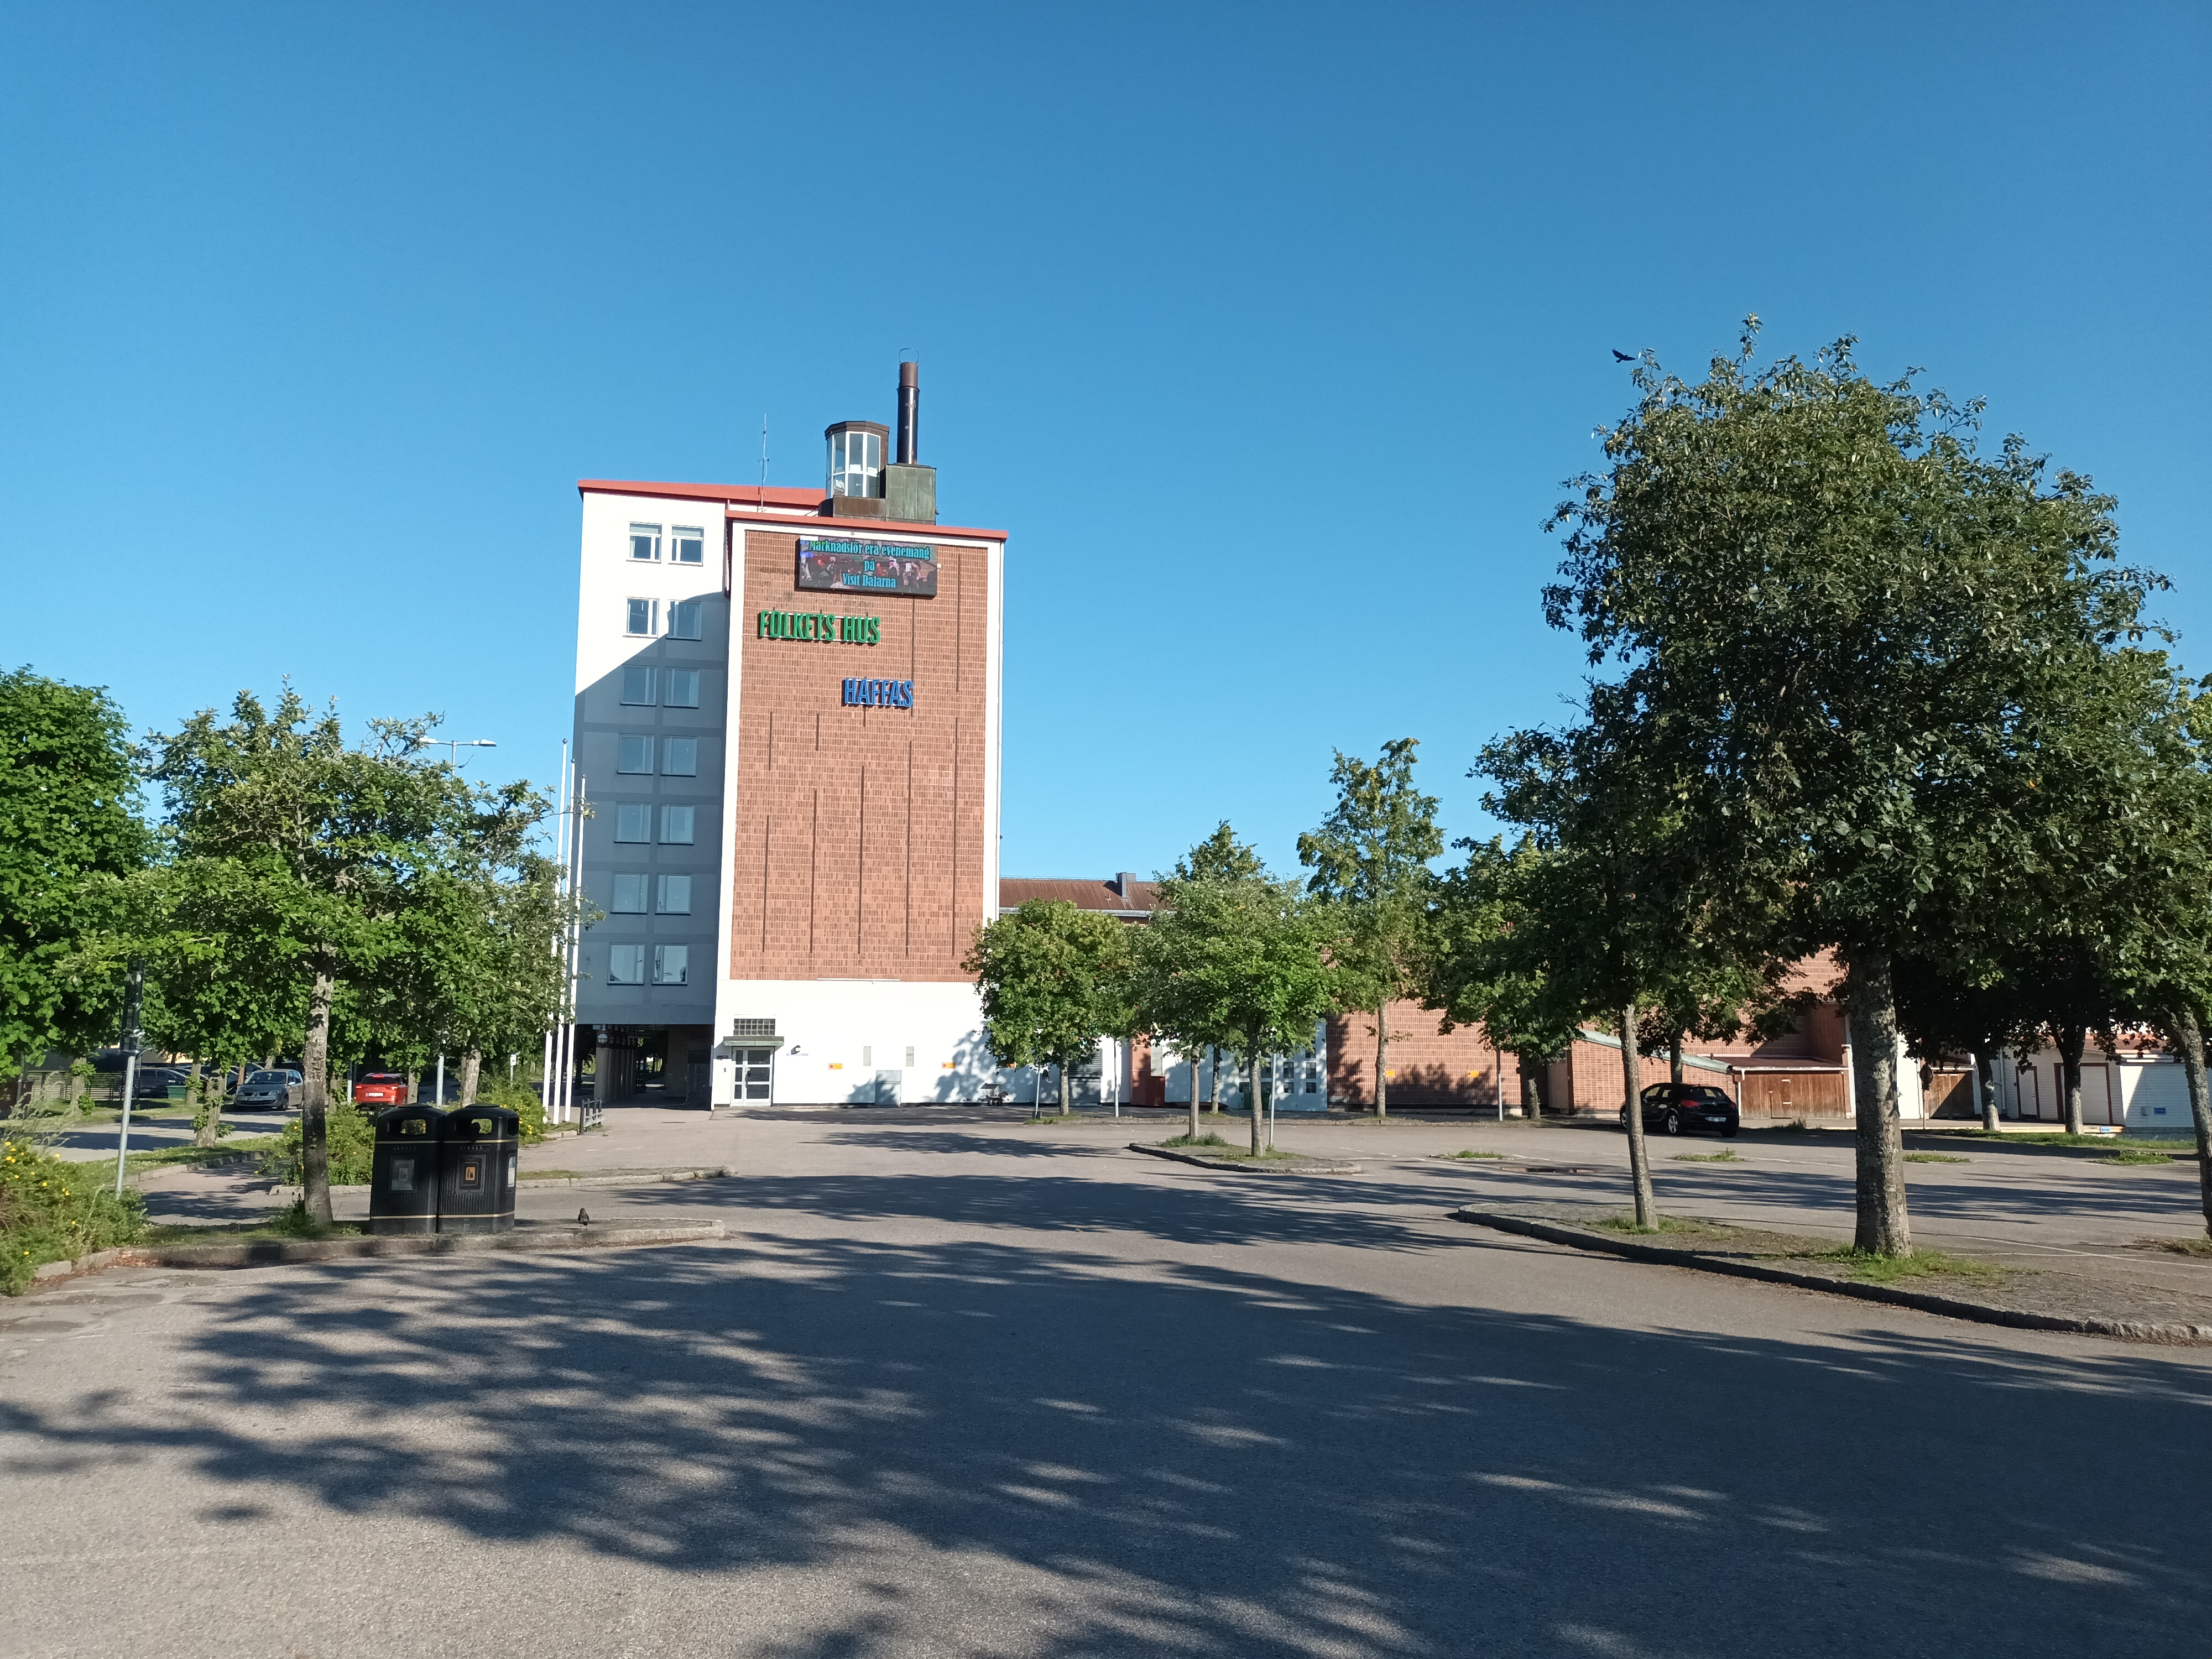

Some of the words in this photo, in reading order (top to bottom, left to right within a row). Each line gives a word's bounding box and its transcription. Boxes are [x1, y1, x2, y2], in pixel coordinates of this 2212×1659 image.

[809, 540, 863, 554] Marknadsför
[864, 544, 879, 555] era
[881, 546, 930, 560] evenemang
[864, 558, 875, 571] på
[842, 573, 859, 586] Visit
[862, 575, 896, 588] Dalarna
[759, 611, 836, 641] FOLKETS
[843, 615, 881, 644] HUS
[844, 677, 914, 707] HAFFAS
